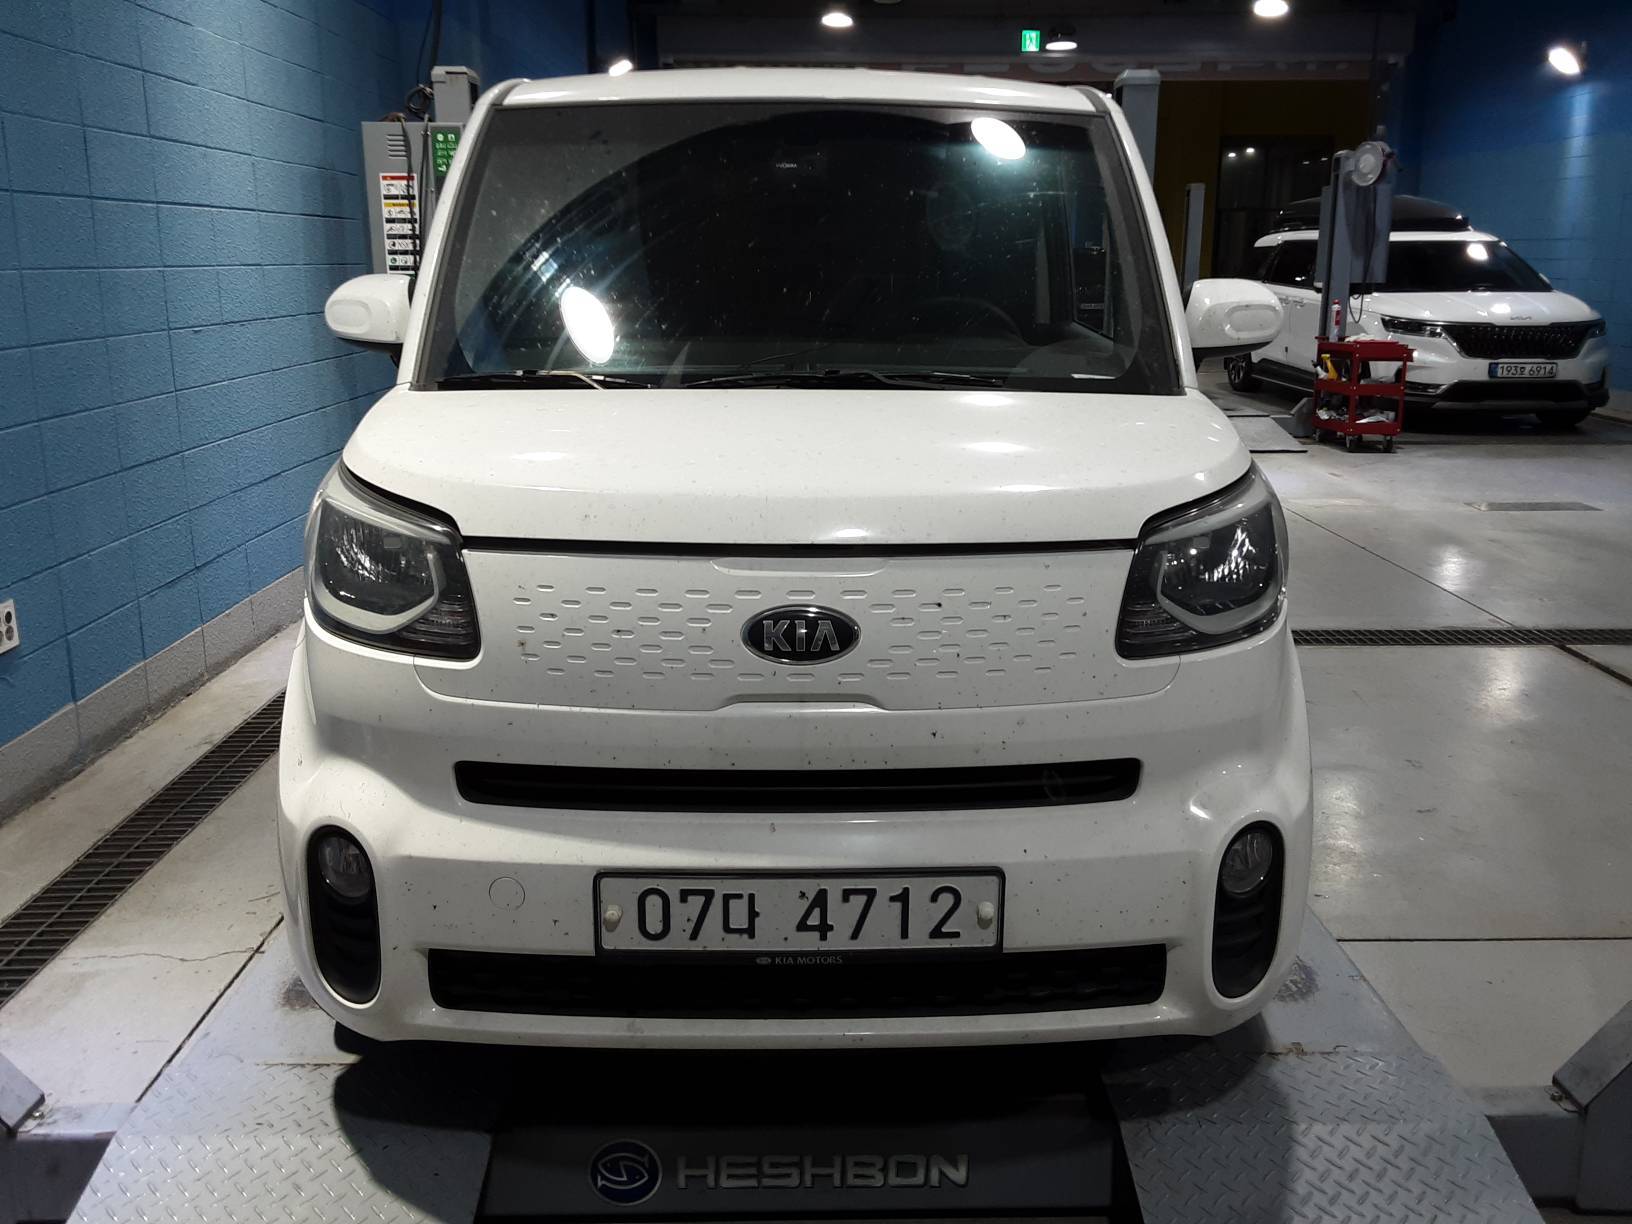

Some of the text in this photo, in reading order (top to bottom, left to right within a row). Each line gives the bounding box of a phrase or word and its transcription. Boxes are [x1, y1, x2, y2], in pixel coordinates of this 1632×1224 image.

[1528, 365, 1554, 376] 6914
[762, 620, 840, 652] KIA
[637, 885, 963, 942] 07다 4712
[775, 956, 794, 966] KIA
[797, 955, 843, 966] MOTORS
[676, 1153, 970, 1190] HESHBON
